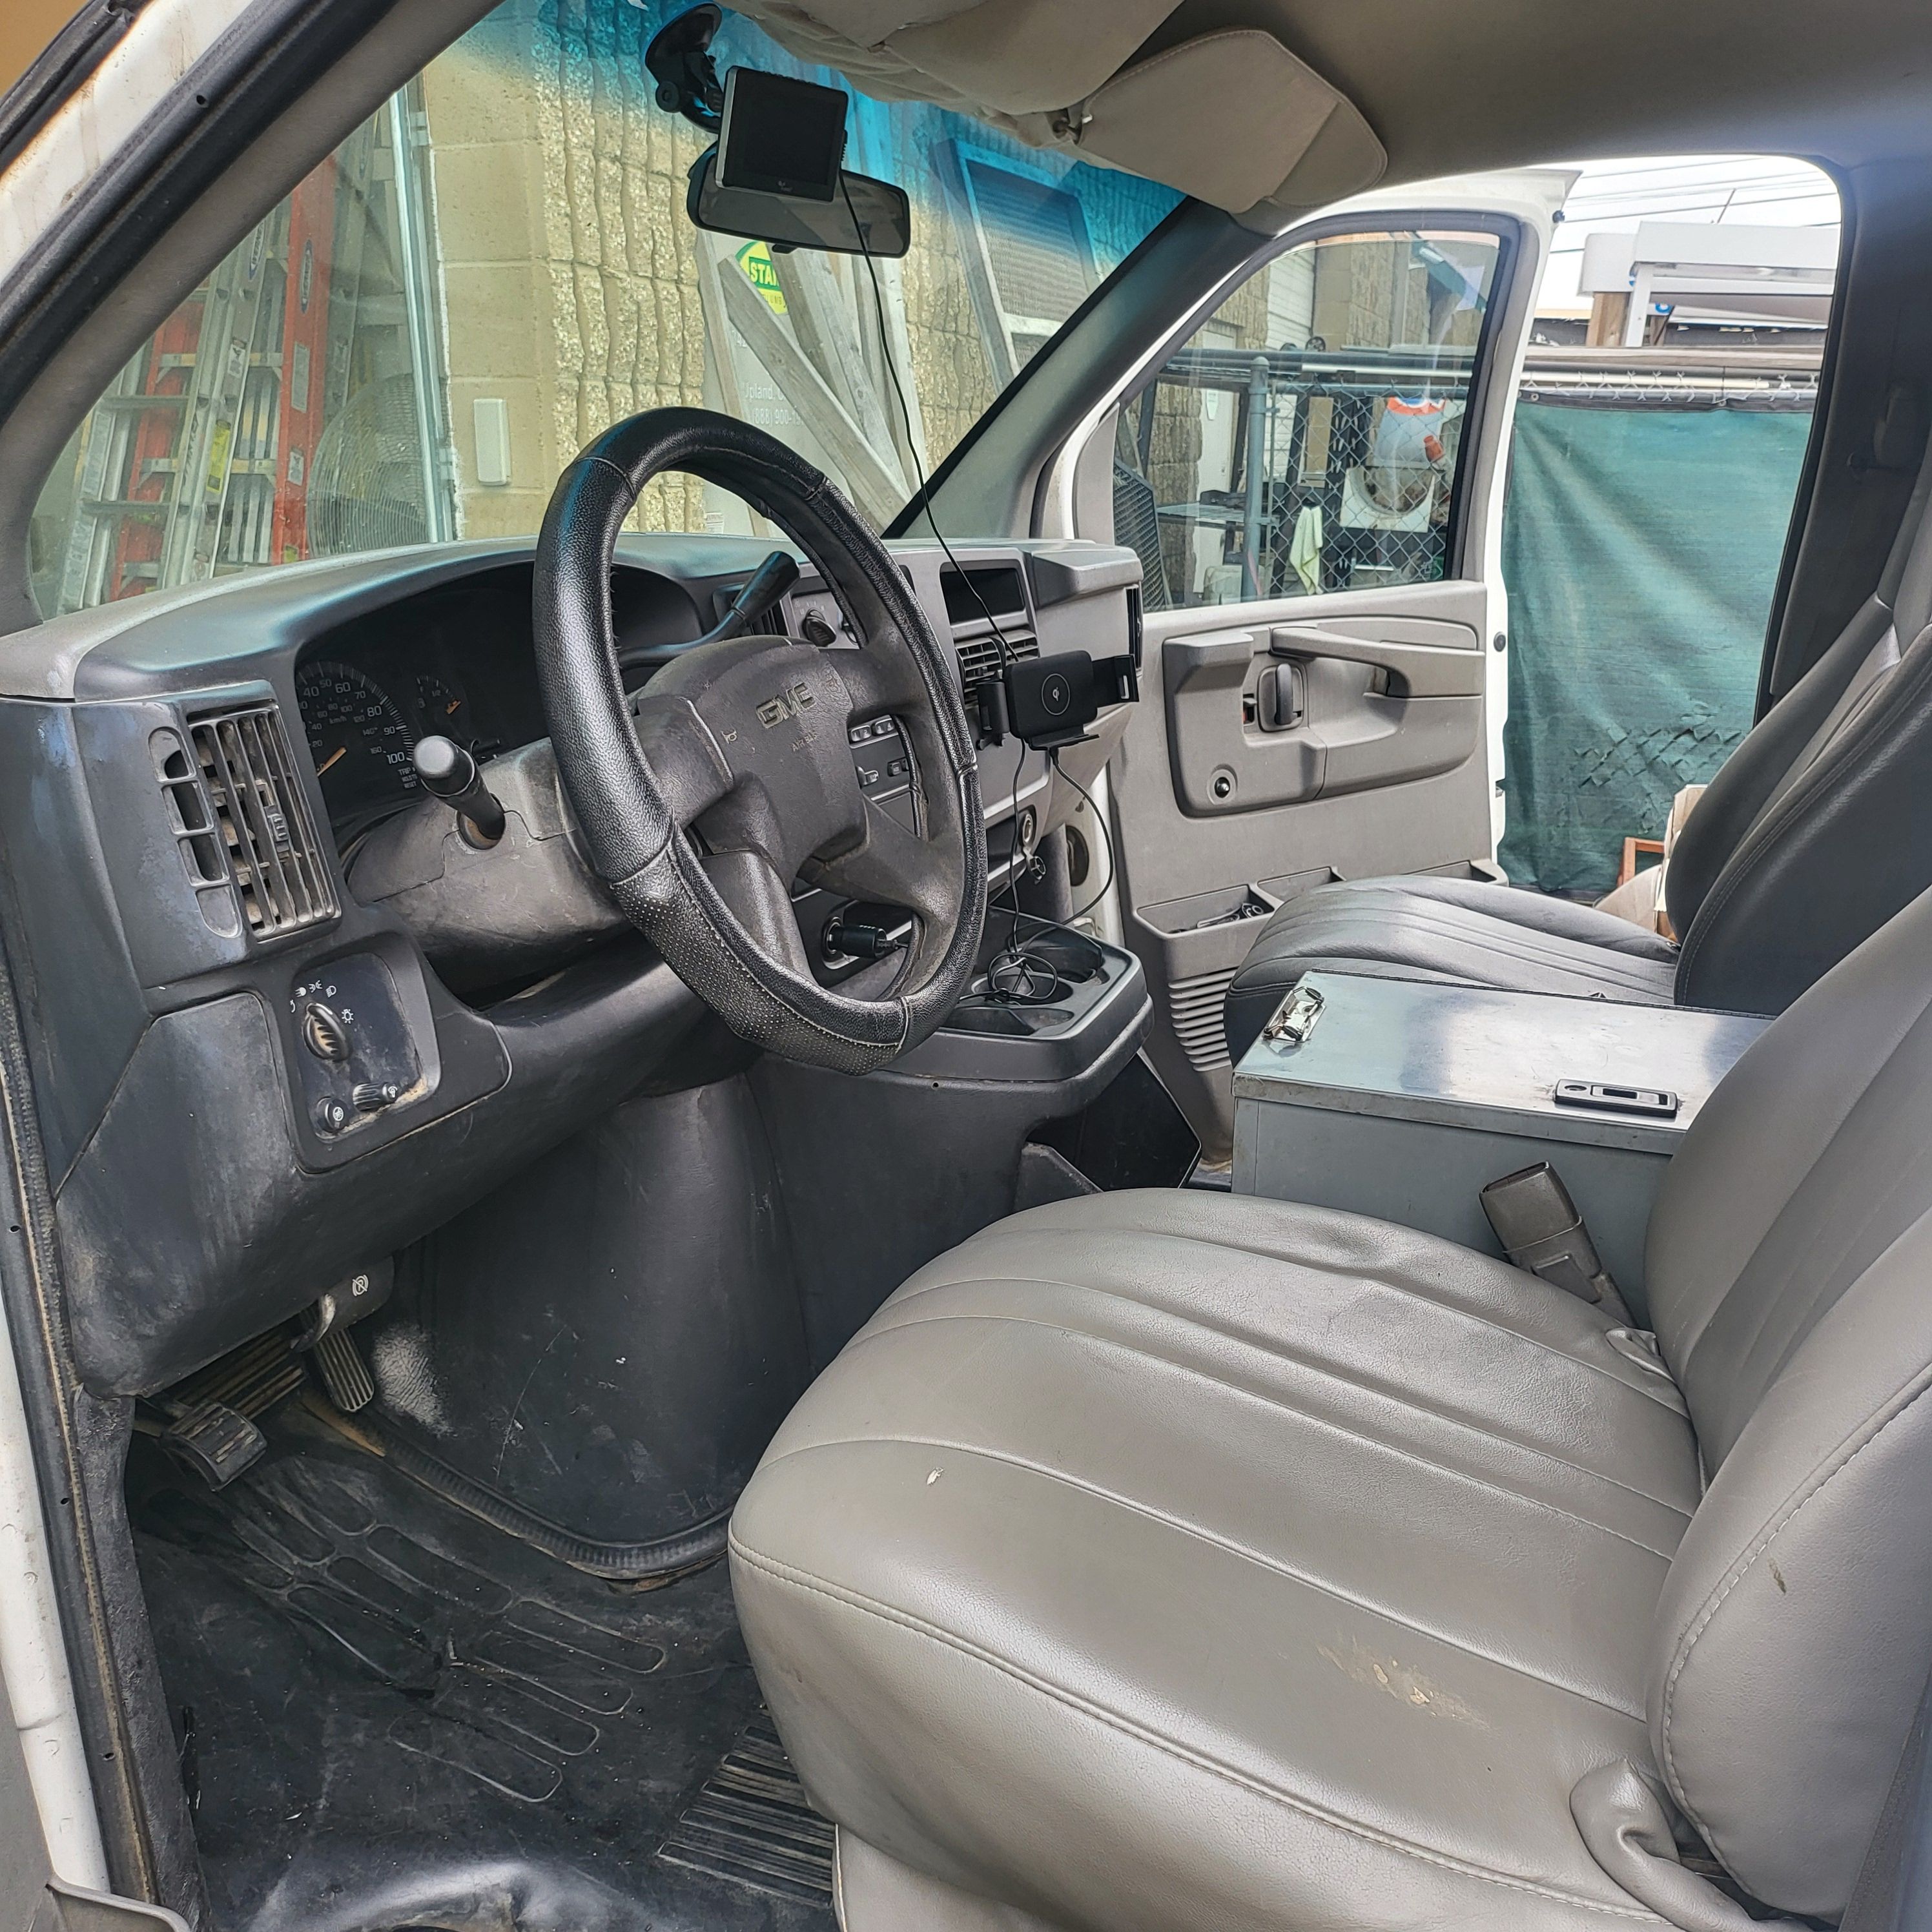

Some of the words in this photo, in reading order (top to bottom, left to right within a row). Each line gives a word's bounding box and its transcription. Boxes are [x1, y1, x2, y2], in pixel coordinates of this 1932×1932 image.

[319, 679, 332, 688] 50
[335, 682, 351, 694] 60
[303, 686, 319, 697] 40
[355, 691, 366, 699] 70
[367, 706, 382, 717] 80
[384, 726, 395, 735] 90
[370, 746, 382, 754] 160
[387, 752, 405, 764] 100
